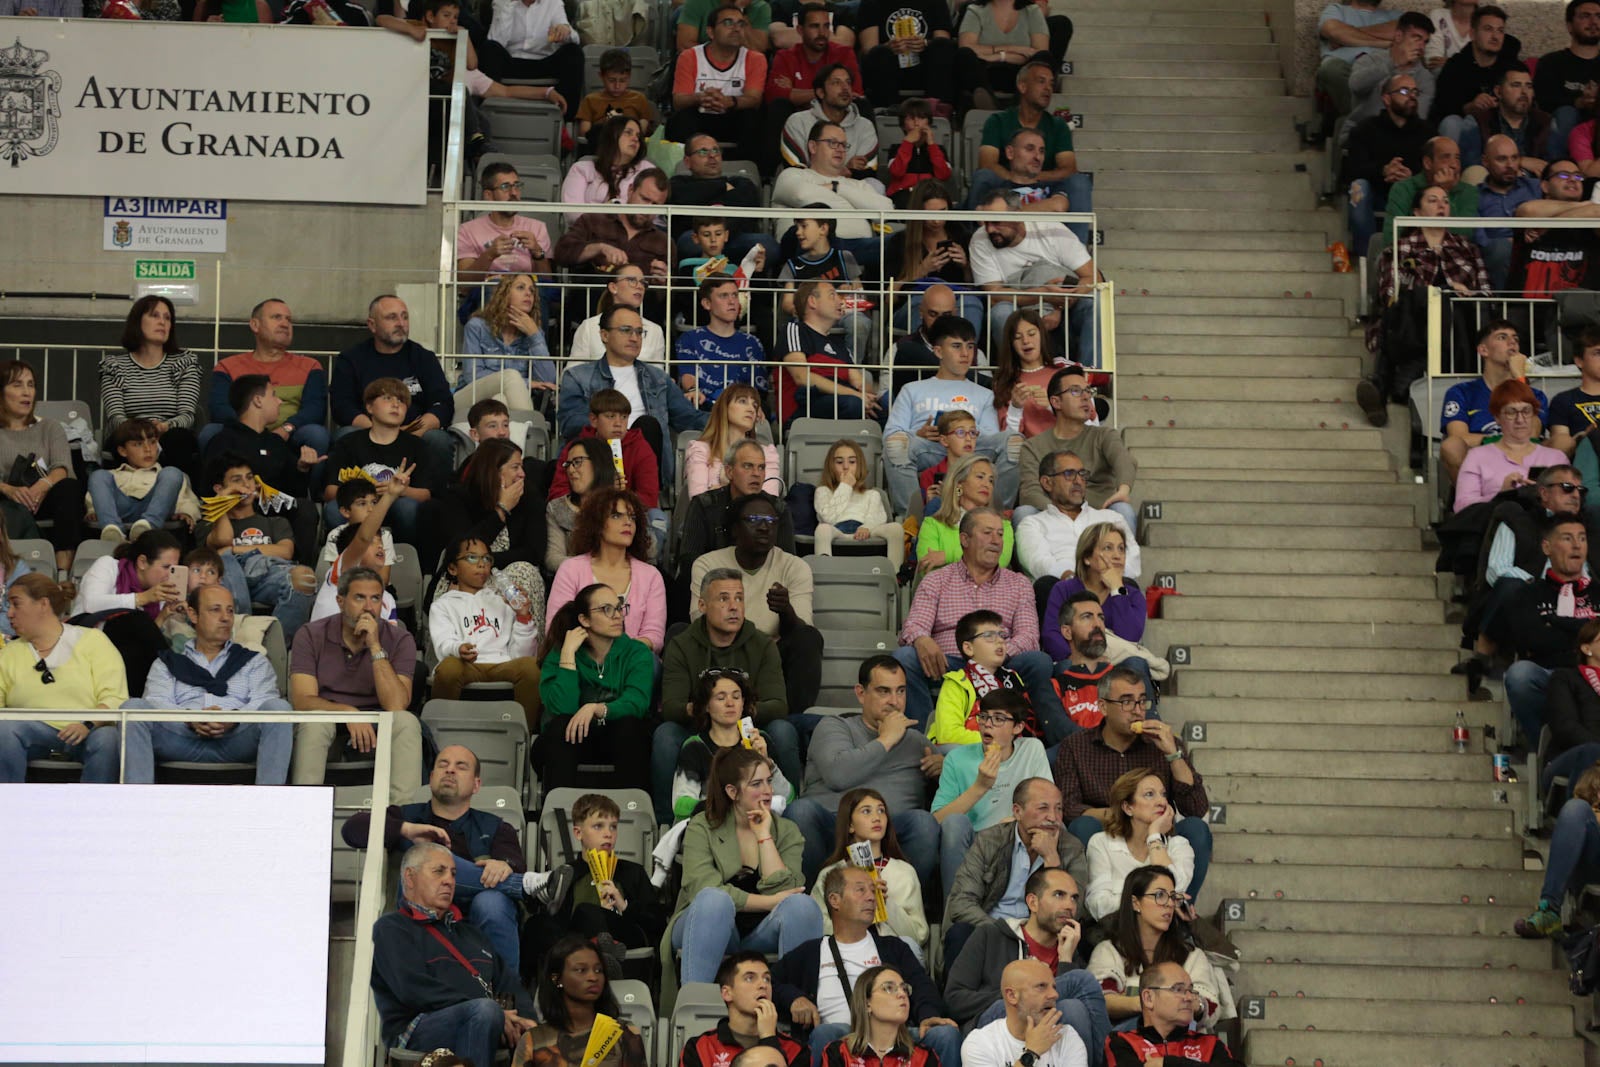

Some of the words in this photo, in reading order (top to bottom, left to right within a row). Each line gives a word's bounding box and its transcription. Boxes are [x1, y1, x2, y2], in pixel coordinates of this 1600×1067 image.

[1062, 62, 1071, 74] 6
[75, 75, 371, 116] AYUNTAMIENTO
[98, 130, 147, 154] DE
[161, 121, 345, 159] GRANADA
[112, 197, 141, 213] A3
[149, 199, 218, 214] IMPAR
[138, 224, 219, 236] AYUNTAMIENTO
[138, 236, 151, 244] DE
[155, 235, 204, 246] GRANADA
[139, 262, 191, 277] SALIDA
[1146, 504, 1160, 517] 11
[1160, 575, 1174, 589] 10
[1175, 647, 1187, 662] 9
[1191, 724, 1203, 740] 8
[1210, 805, 1222, 821] 7
[1229, 903, 1241, 919] 6
[1247, 1000, 1260, 1016] 5
